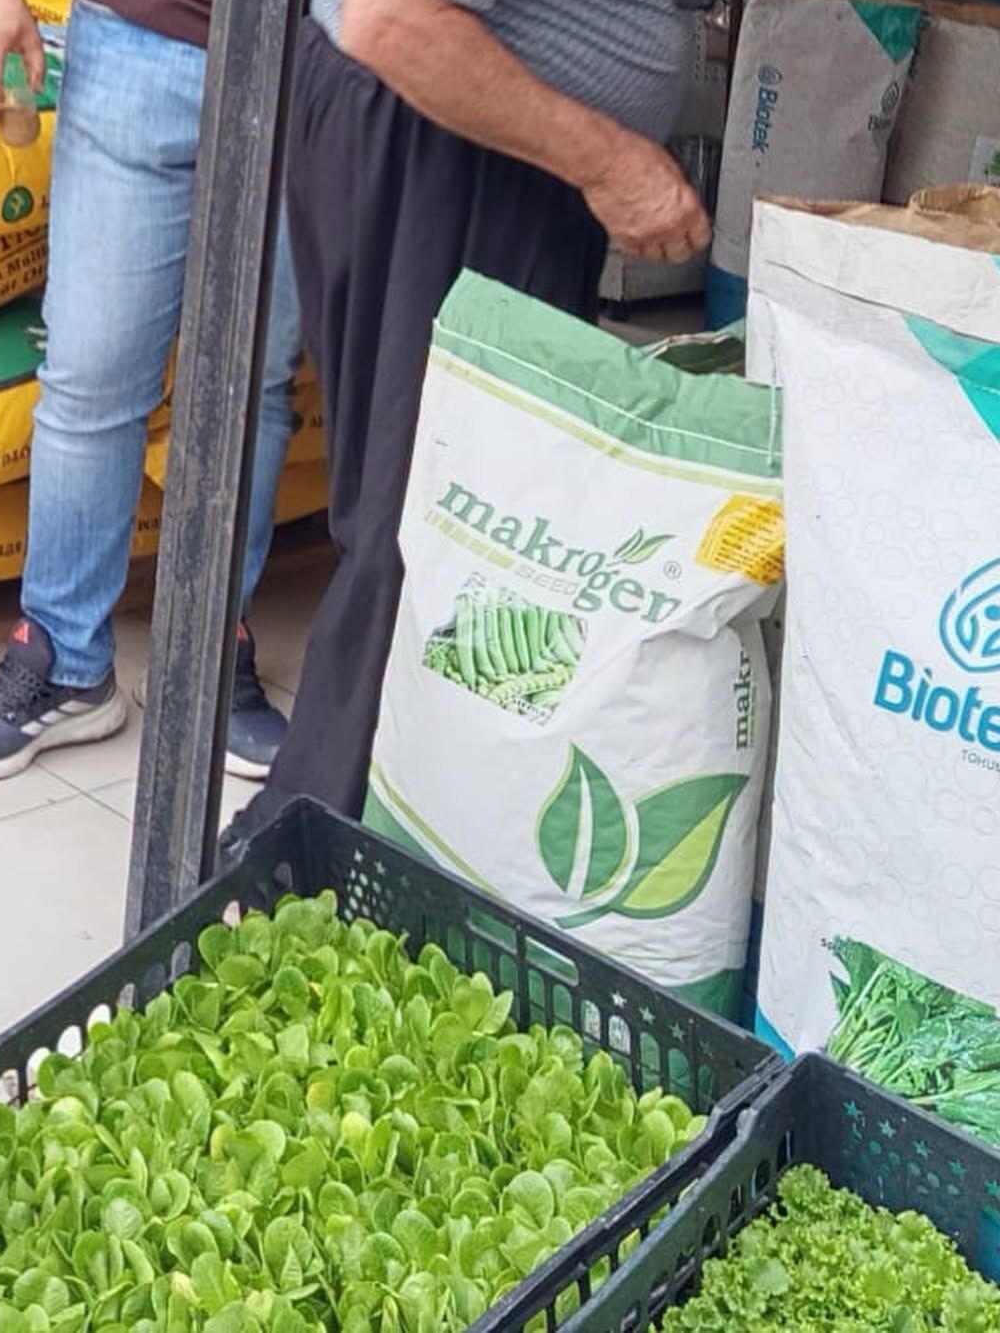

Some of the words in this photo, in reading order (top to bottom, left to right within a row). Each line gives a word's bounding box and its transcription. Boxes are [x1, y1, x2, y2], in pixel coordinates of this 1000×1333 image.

[752, 87, 778, 154] Biotek
[437, 481, 682, 624] makrogen
[734, 651, 753, 751] makr
[874, 649, 1000, 753] Biote
